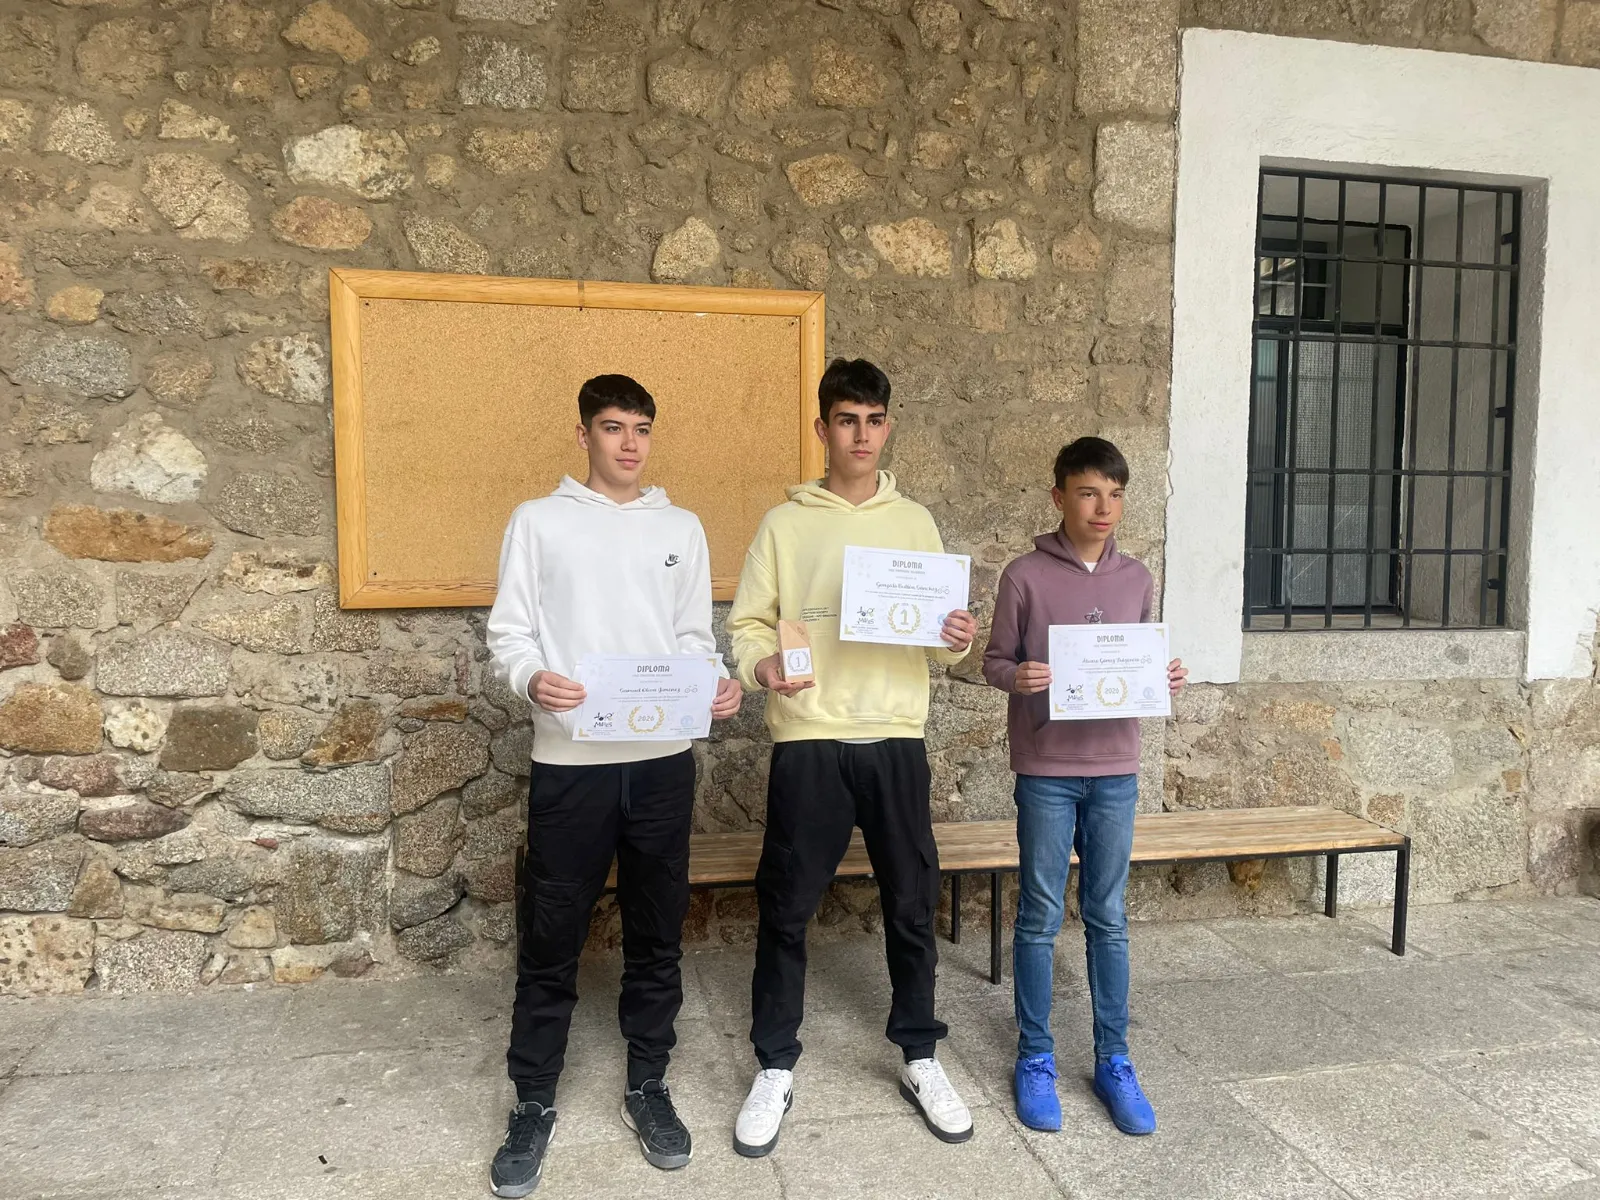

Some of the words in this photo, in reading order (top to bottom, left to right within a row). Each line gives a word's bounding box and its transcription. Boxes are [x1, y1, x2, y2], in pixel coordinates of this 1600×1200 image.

[892, 560, 923, 569] DIPLOMA
[900, 608, 909, 626] 1
[795, 656, 801, 668] 1
[637, 665, 670, 673] DIPLOMA
